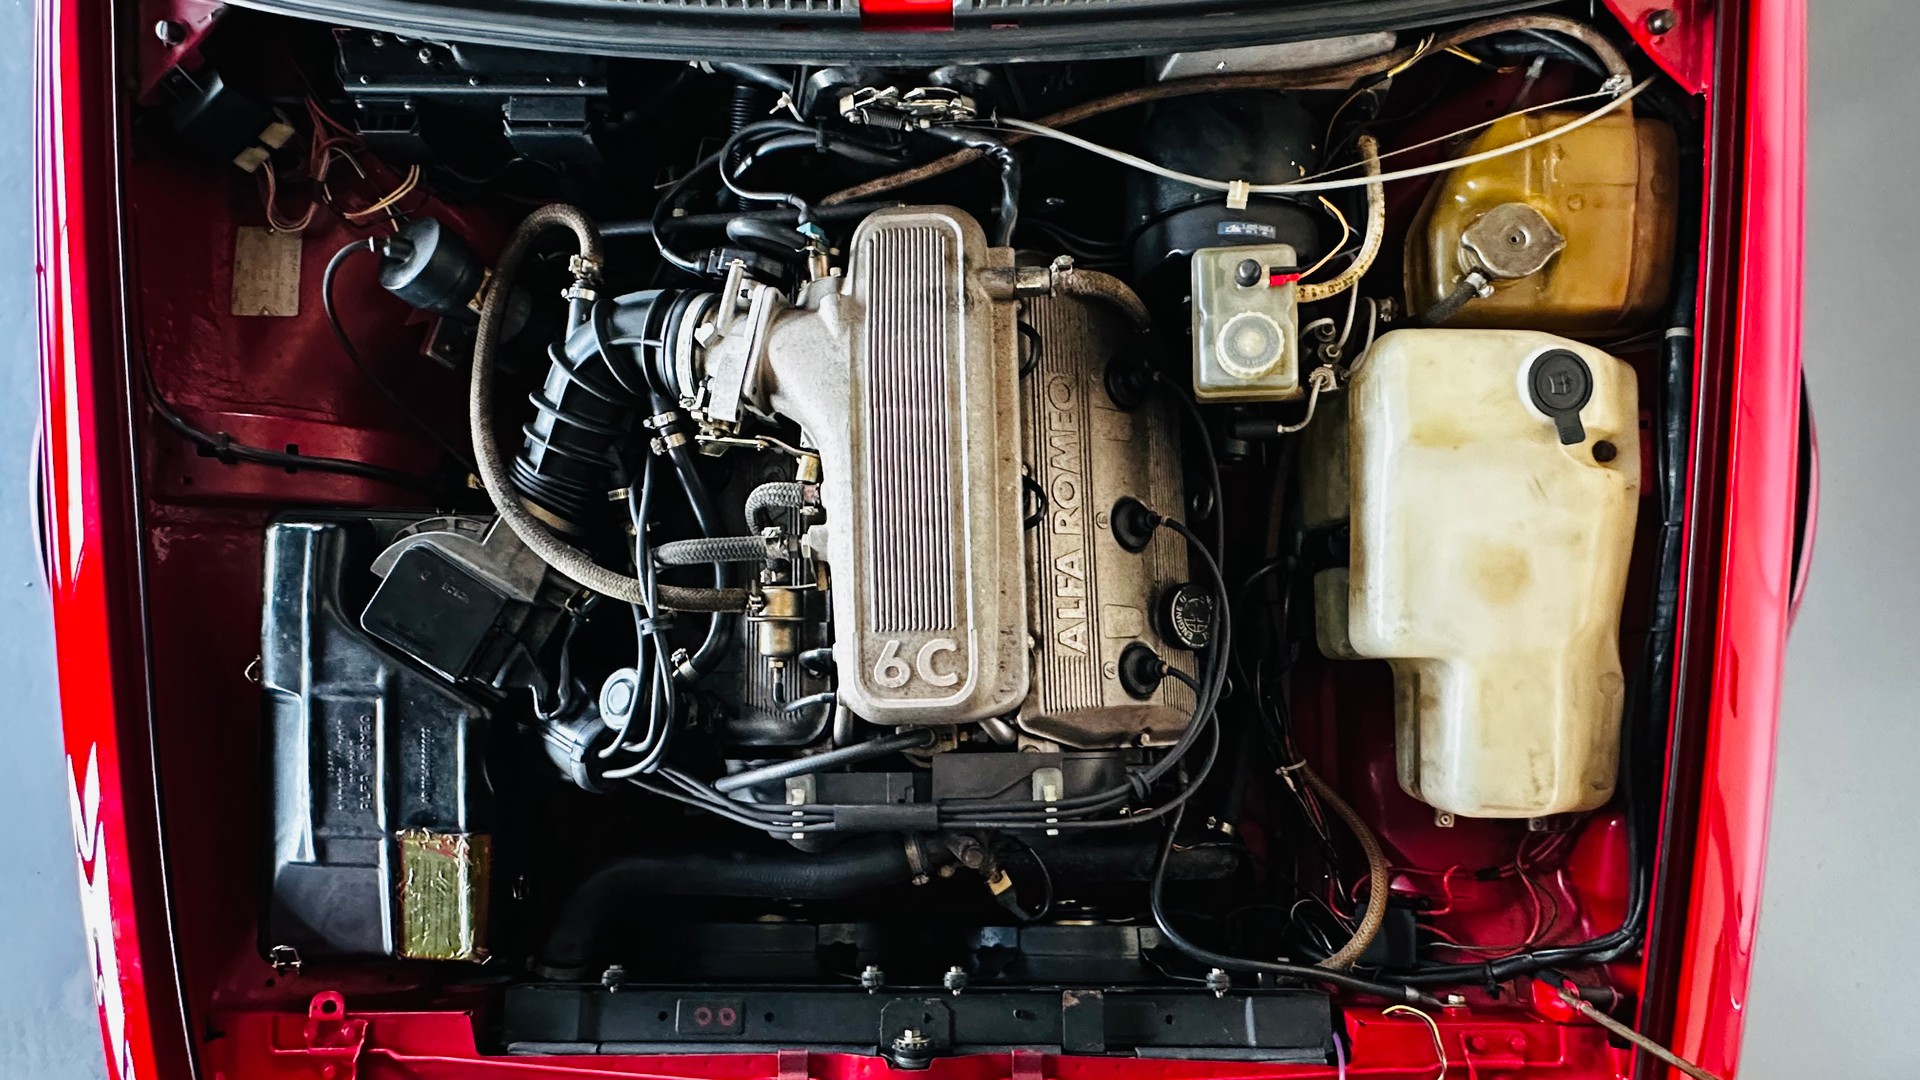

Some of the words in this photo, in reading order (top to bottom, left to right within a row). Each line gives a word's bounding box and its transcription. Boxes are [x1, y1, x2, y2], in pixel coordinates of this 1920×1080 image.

[1047, 375, 1082, 536] ROMEO
[1055, 549, 1087, 655] ALFA
[1175, 604, 1194, 640] ENGINE
[873, 638, 959, 688] 6C
[359, 714, 372, 760] ROMEO
